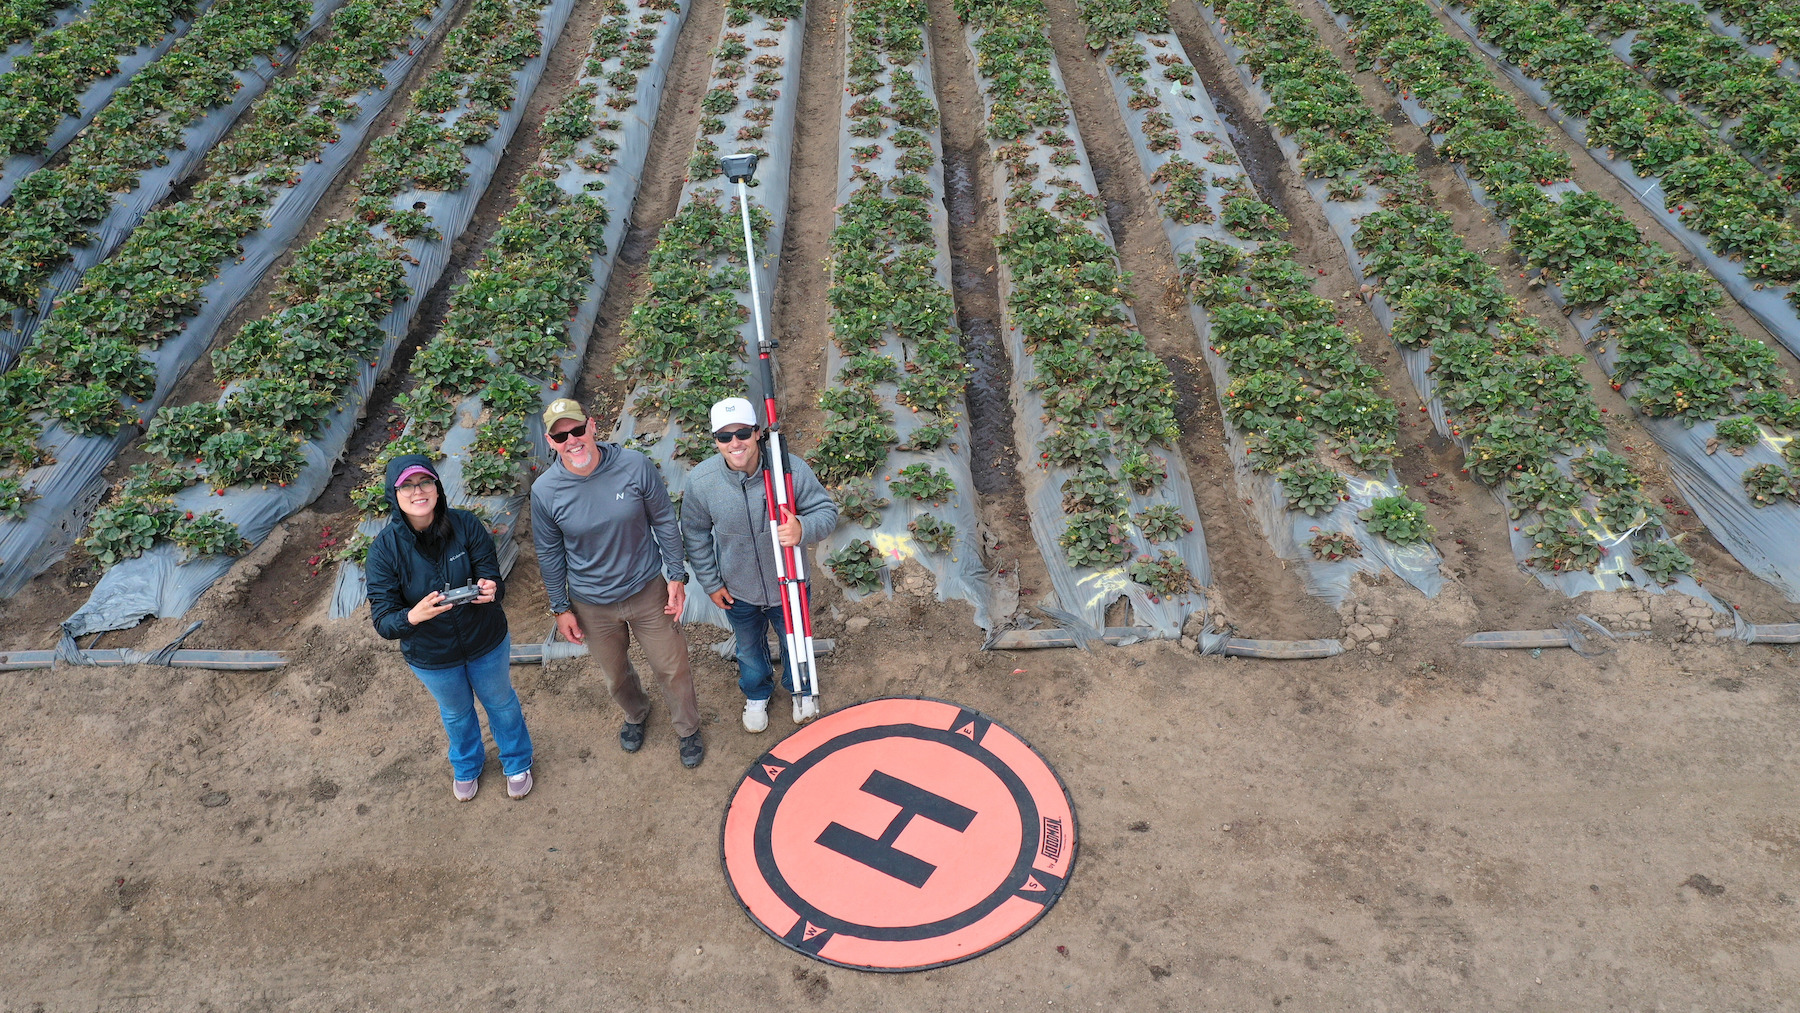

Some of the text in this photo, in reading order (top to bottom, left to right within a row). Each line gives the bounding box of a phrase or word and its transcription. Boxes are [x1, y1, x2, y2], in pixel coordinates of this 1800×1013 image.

[616, 492, 624, 501] N
[768, 767, 778, 776] N
[814, 769, 979, 889] H
[1041, 816, 1062, 863] HOODMAN
[805, 926, 817, 936] W
